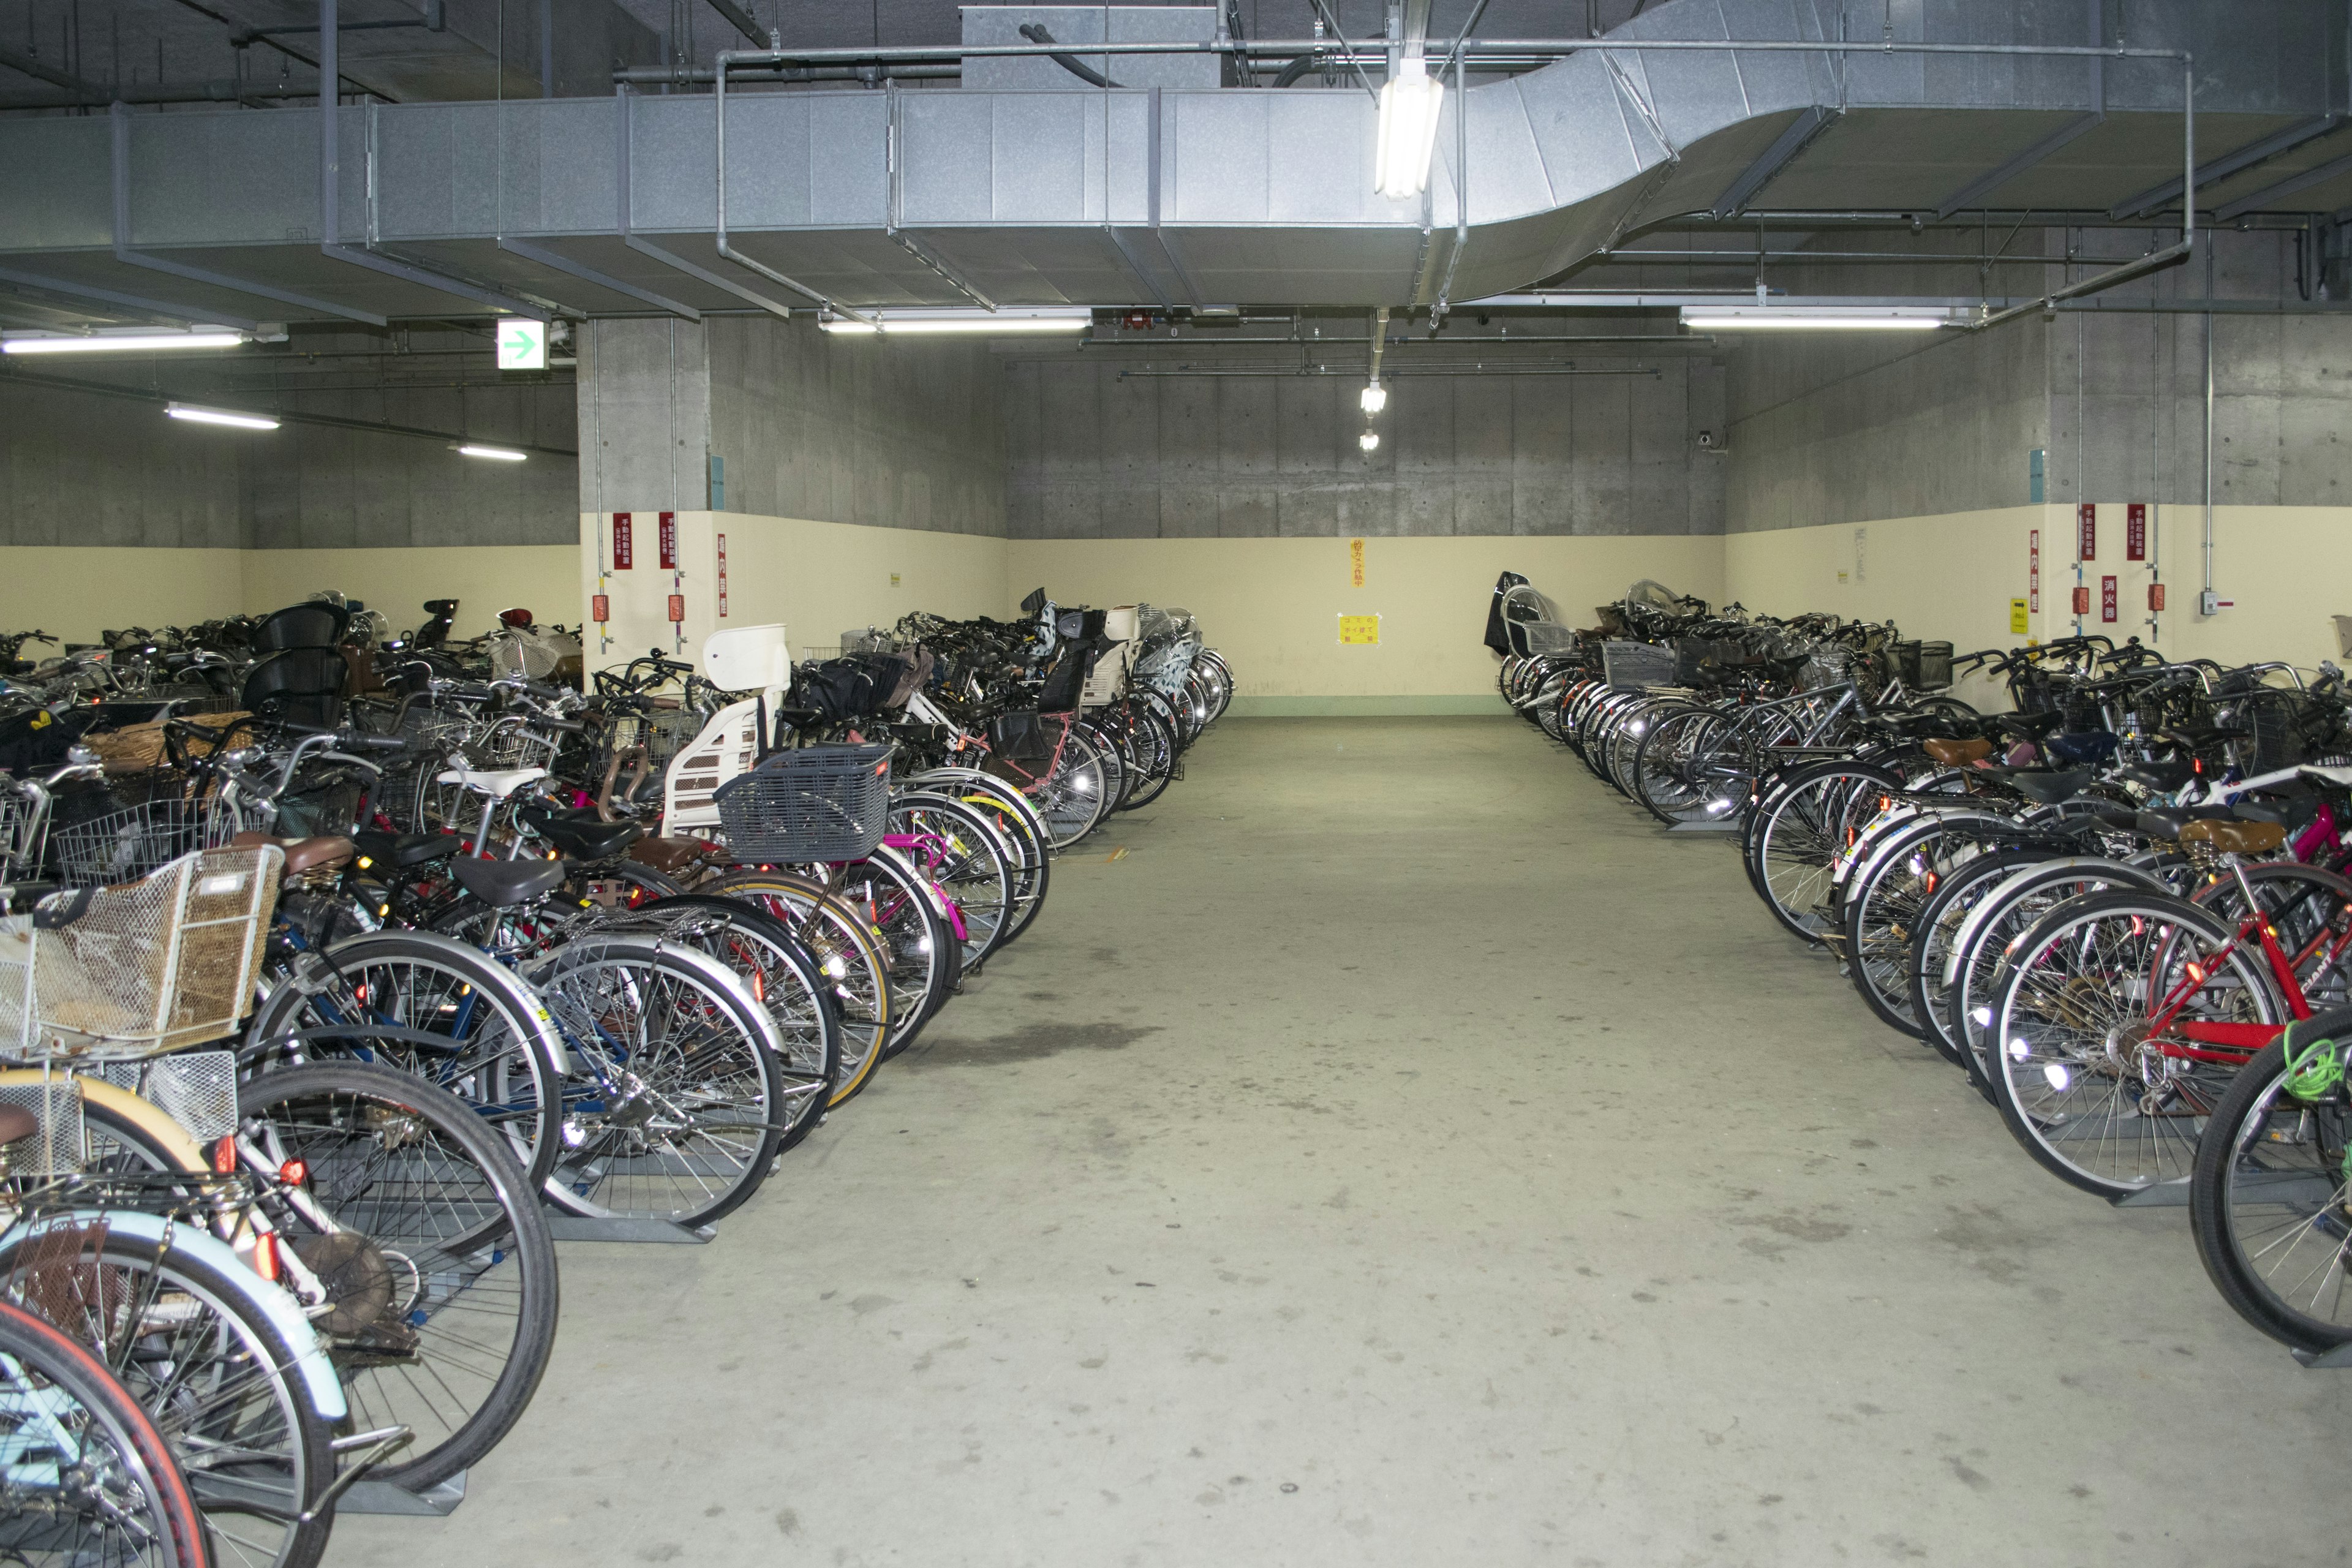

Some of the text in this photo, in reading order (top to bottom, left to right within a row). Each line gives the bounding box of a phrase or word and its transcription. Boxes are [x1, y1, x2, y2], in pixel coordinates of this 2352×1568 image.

[718, 537, 727, 614] 場内禁煙
[1354, 540, 1362, 586] 防犯カメラ作動中
[2105, 579, 2114, 619] 消火器
[2301, 953, 2332, 995] GIANT
